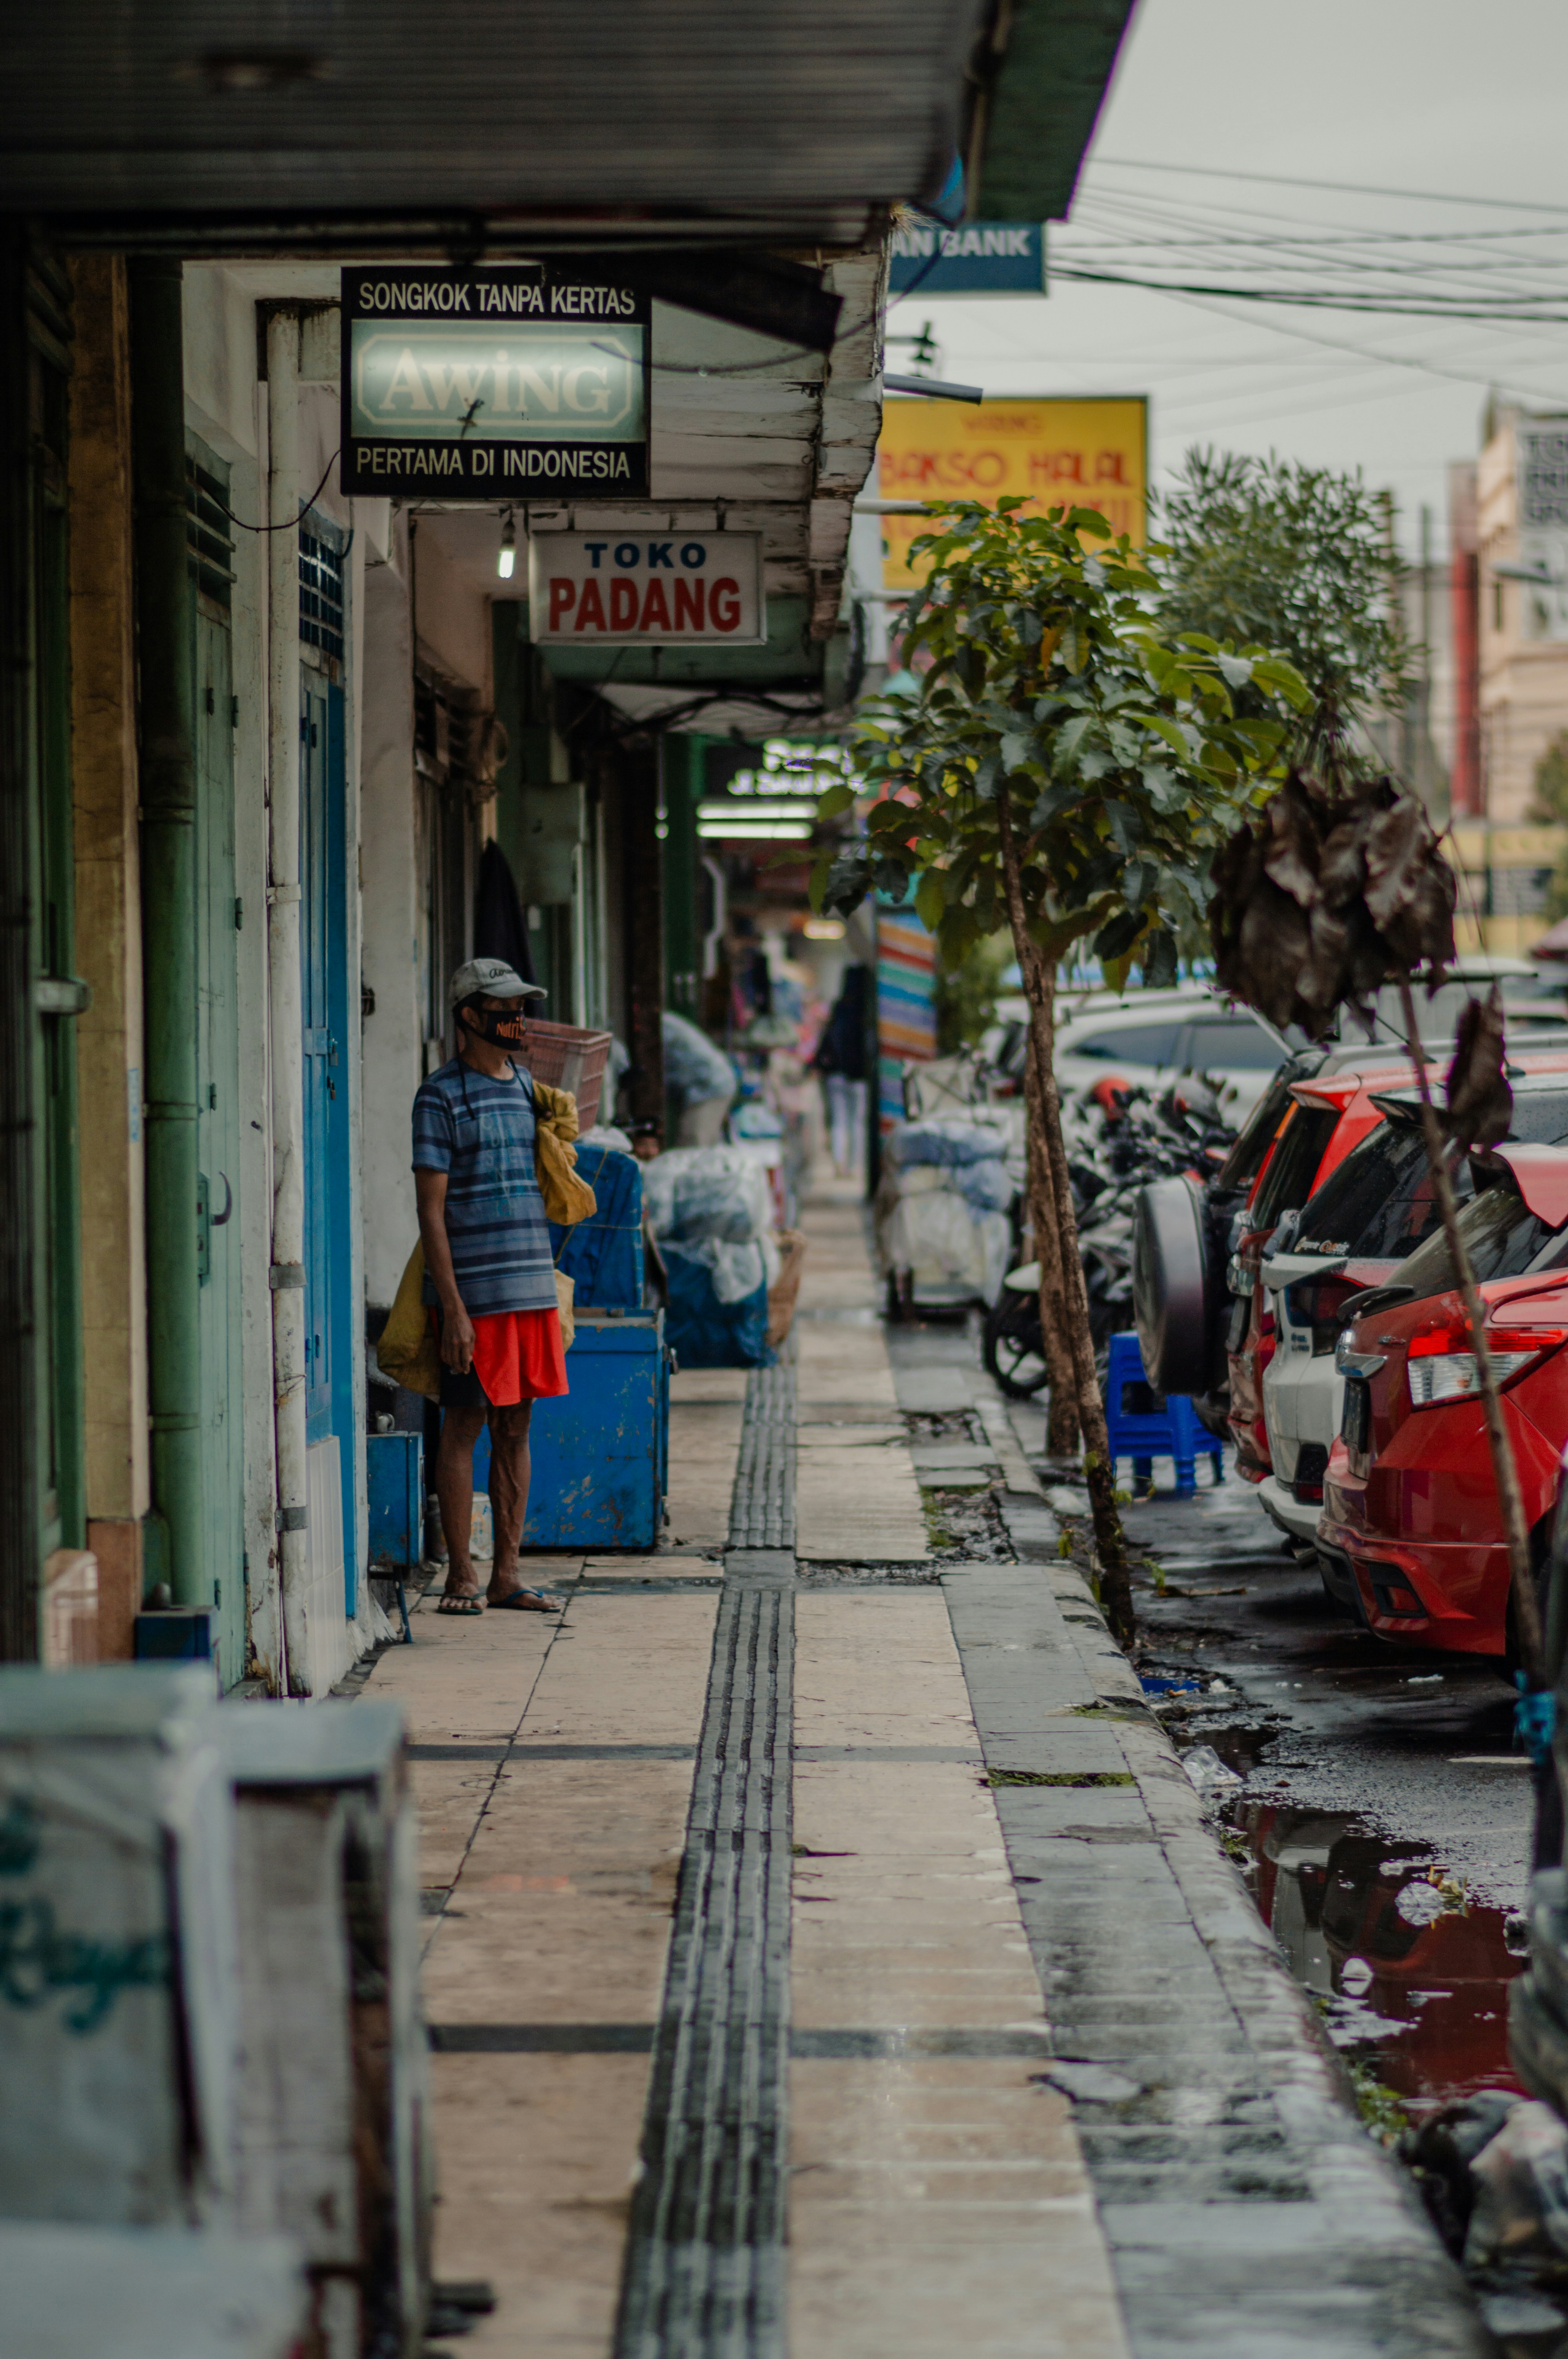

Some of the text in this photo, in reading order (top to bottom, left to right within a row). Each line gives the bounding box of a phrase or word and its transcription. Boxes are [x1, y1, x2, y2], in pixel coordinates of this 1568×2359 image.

[939, 230, 1031, 257] BANK
[359, 282, 635, 314] SONGKOK TANPA KERTAS
[357, 447, 630, 478] PERTAMA DI INDONESIA
[879, 450, 1007, 488] BAKSO
[584, 543, 706, 569] TOKO
[550, 577, 740, 632] PADANG
